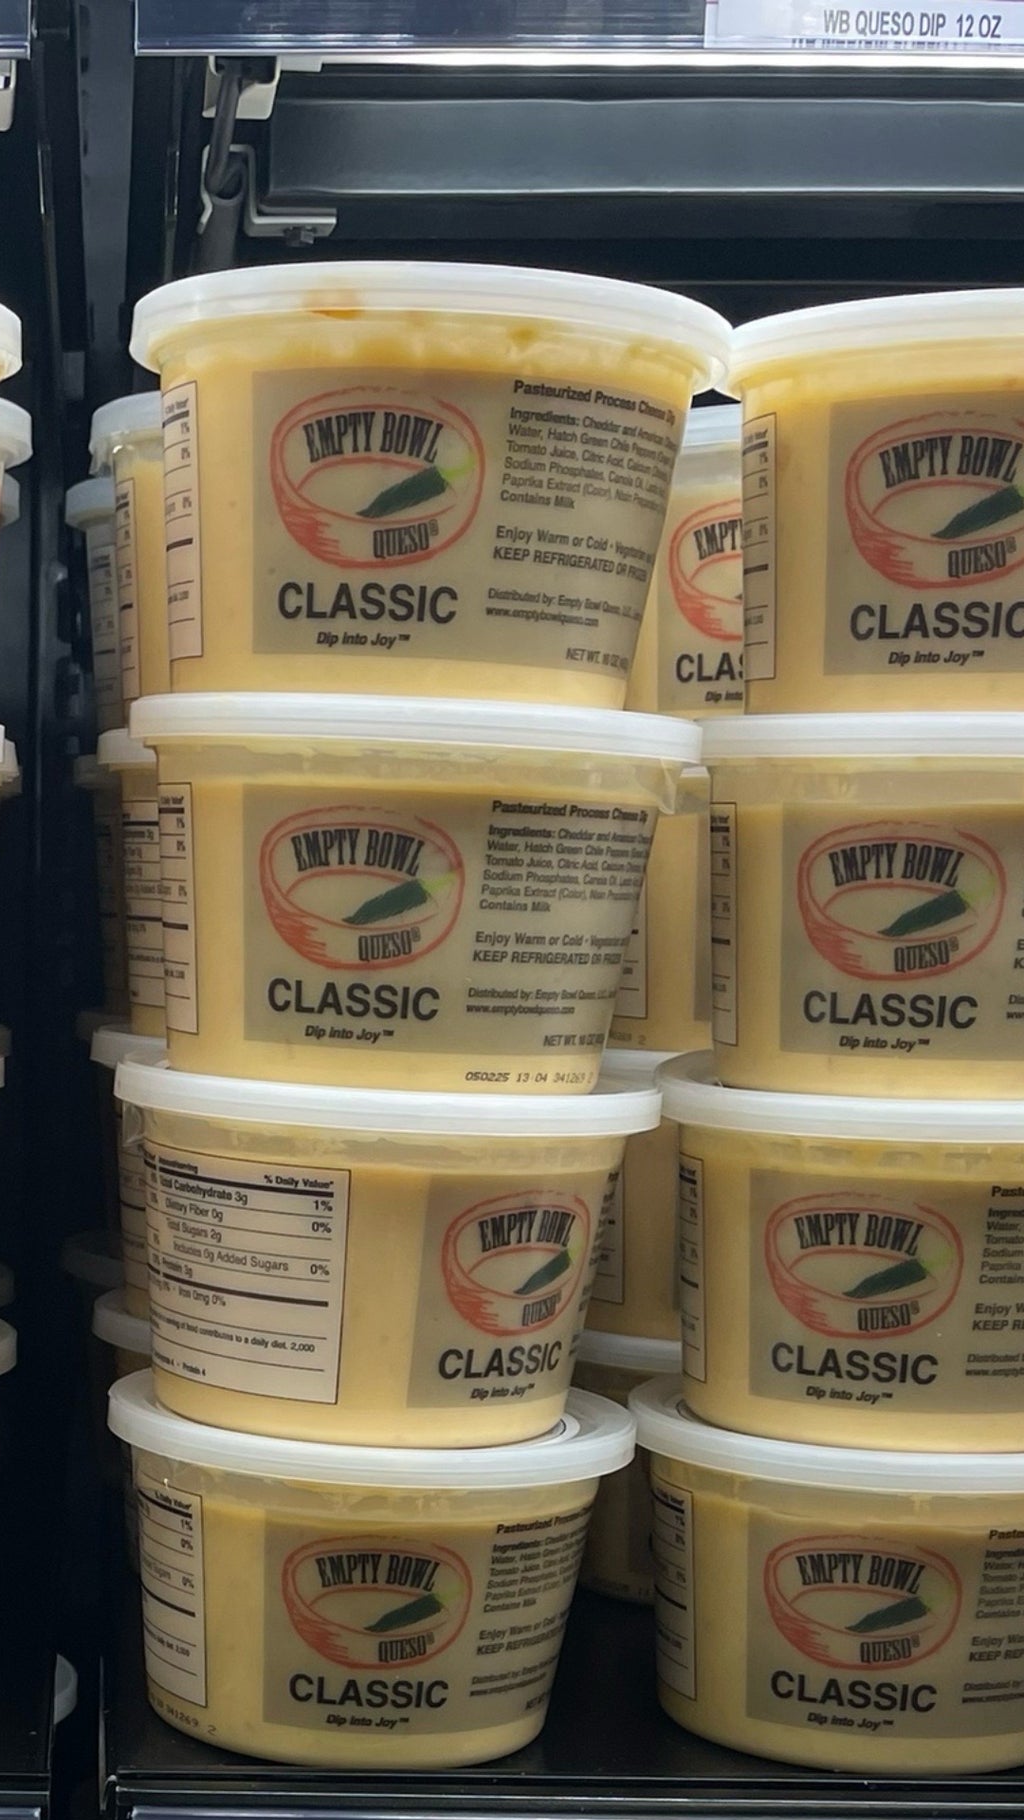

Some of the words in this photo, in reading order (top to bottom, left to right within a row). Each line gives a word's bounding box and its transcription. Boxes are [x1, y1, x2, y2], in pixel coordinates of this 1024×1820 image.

[824, 9, 850, 34] WB
[855, 11, 914, 37] QUESO
[920, 14, 946, 37] DIP
[956, 14, 974, 38] 12
[978, 15, 1002, 39] OZ
[303, 412, 378, 463] EMPTY
[379, 414, 445, 464] BOWL
[878, 435, 953, 489] EMPTY
[957, 434, 1024, 483] BOWL
[277, 582, 458, 625] CLASSIC
[291, 829, 360, 873] EMPTY
[365, 829, 426, 876] BOWL
[266, 977, 440, 1023] CLASSIC
[803, 990, 979, 1030] CLASSIC
[234, 1191, 248, 1207] 3g
[438, 1340, 563, 1382] CLASSIC
[771, 1342, 939, 1385] CLASSIC
[315, 1553, 382, 1590] EMPTY
[385, 1554, 441, 1592] BOWL
[288, 1673, 449, 1710] CLASSIC
[770, 1670, 938, 1713] CLASSIC
